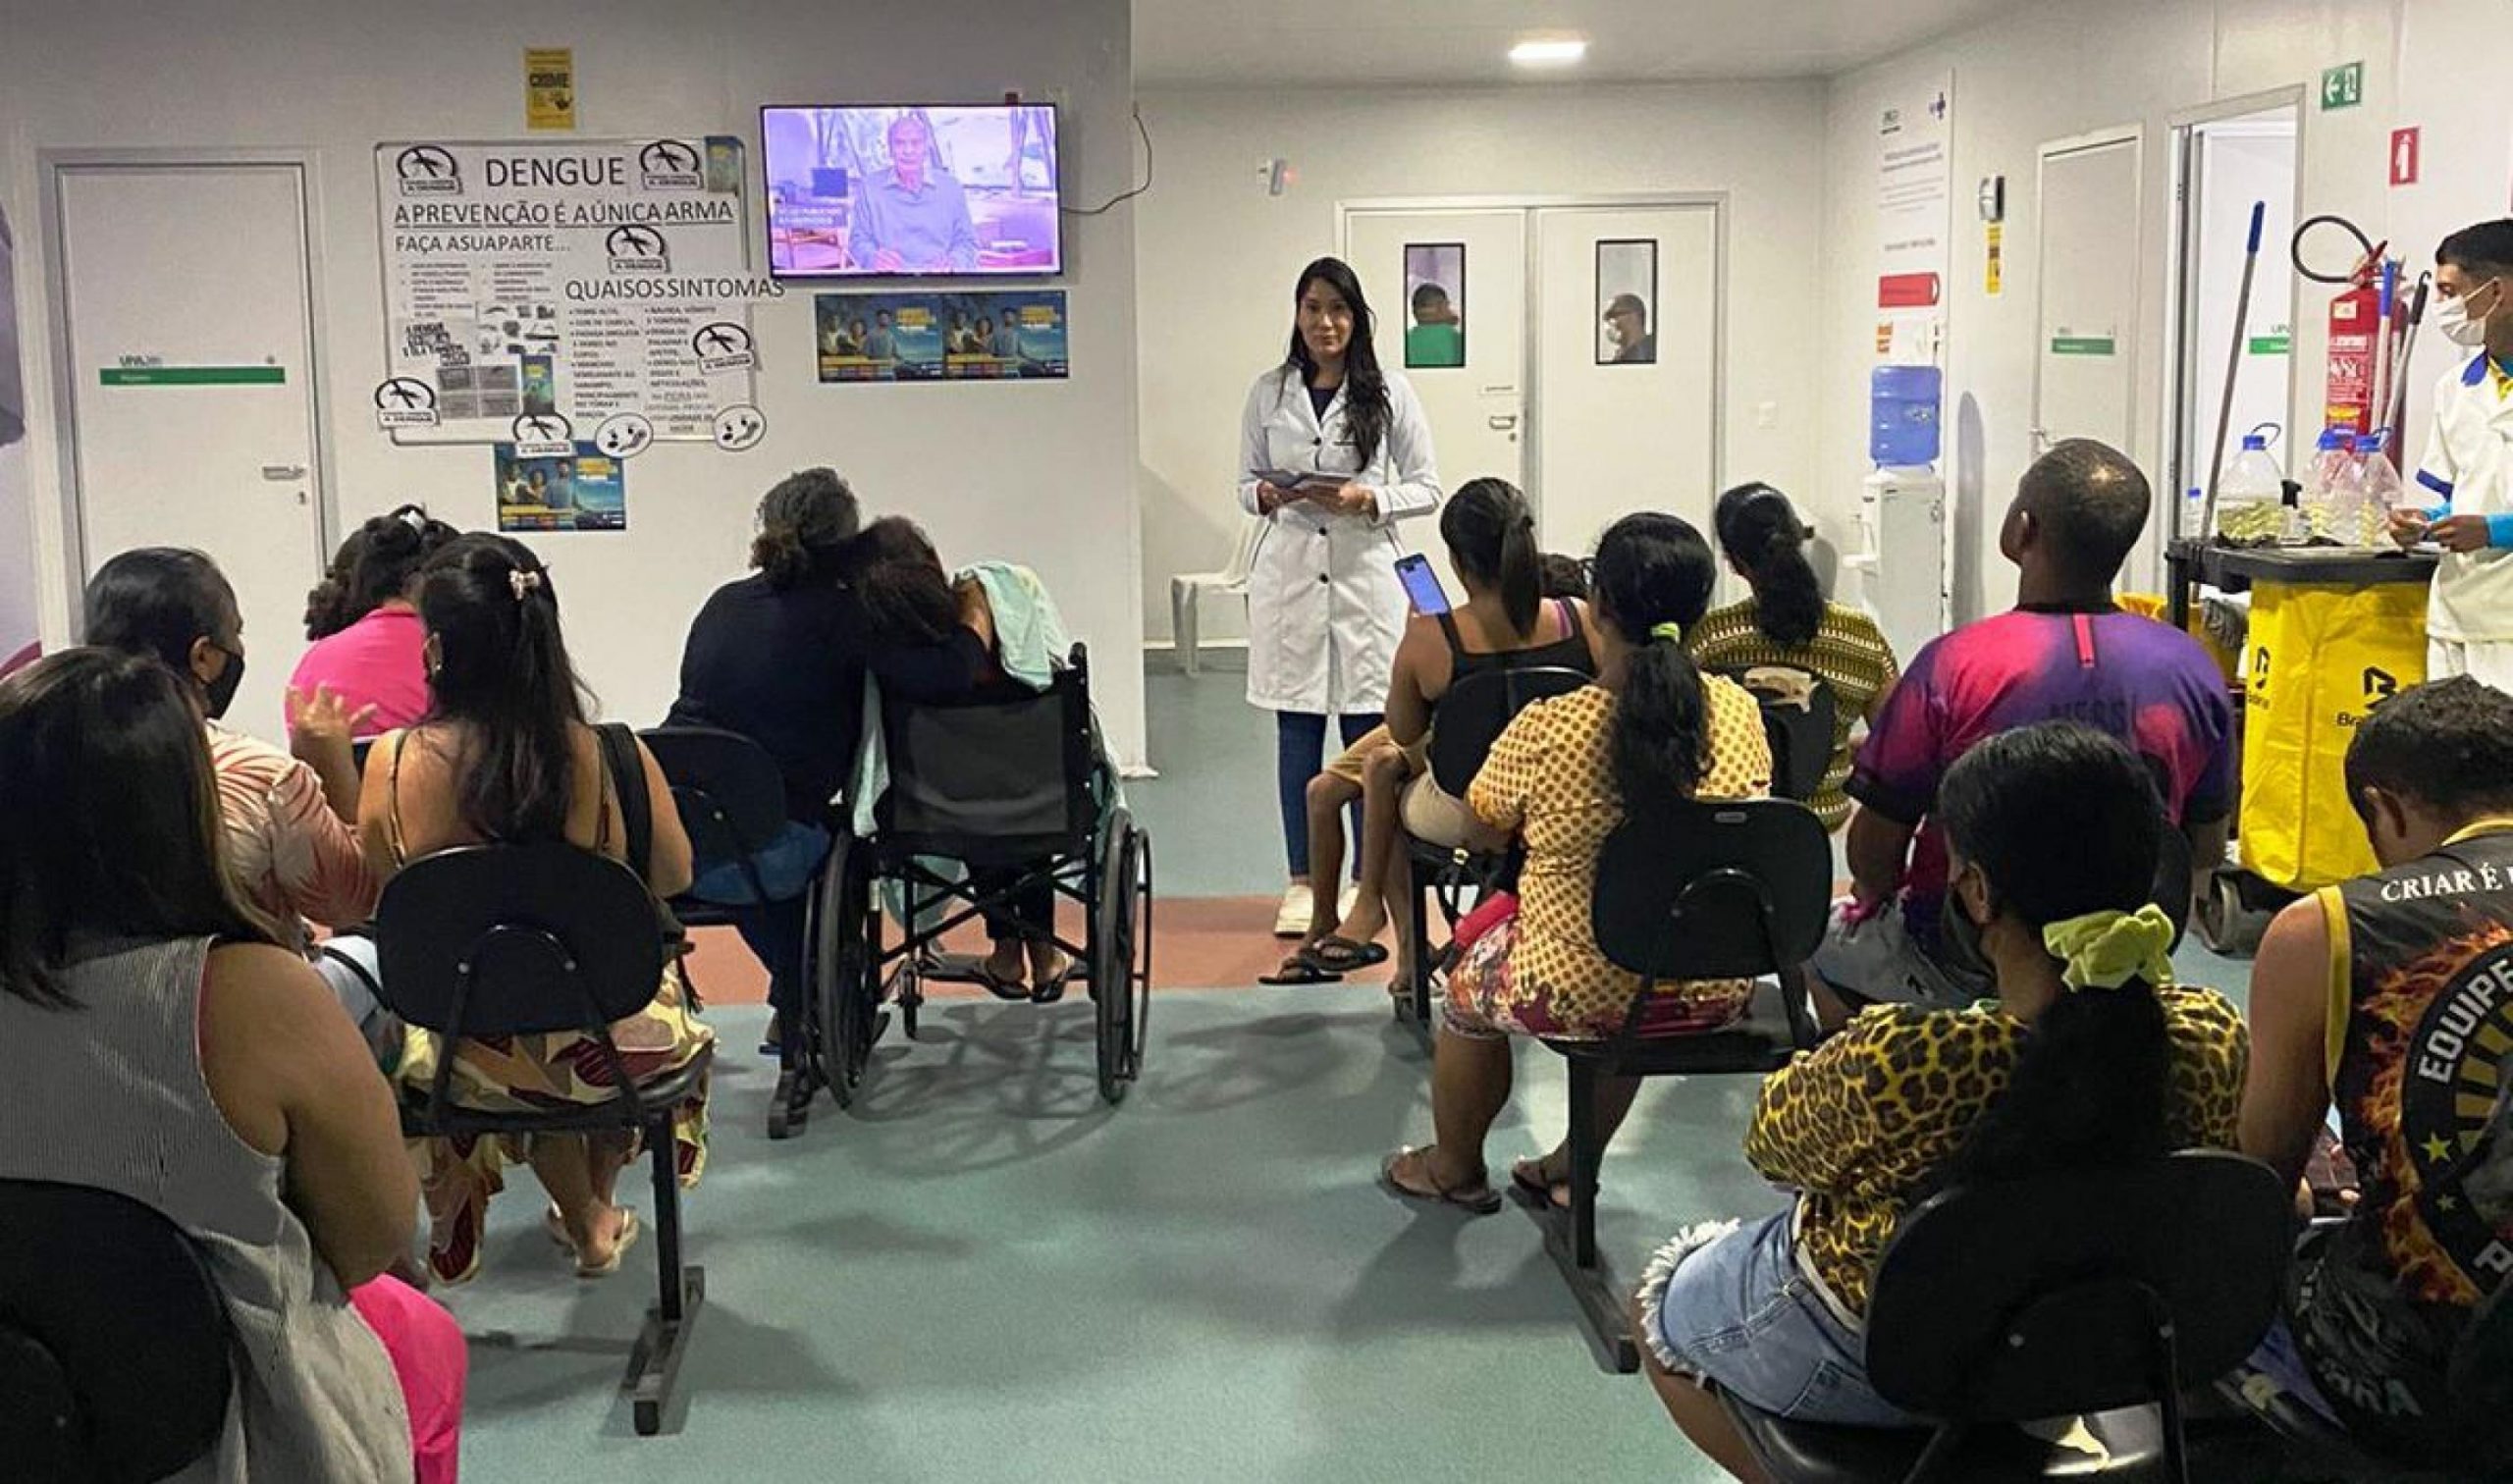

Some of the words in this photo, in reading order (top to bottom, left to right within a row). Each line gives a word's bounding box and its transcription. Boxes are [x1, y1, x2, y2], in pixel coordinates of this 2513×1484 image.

[485, 157, 625, 187] DENGUE
[555, 199, 566, 223] É
[665, 199, 734, 220] ARMA
[395, 236, 443, 254] FAÇA
[667, 278, 785, 299] SINTOMAS
[2380, 870, 2476, 902] CRIAR
[2480, 862, 2503, 890] É
[2418, 957, 2513, 1084] EQUIPE
